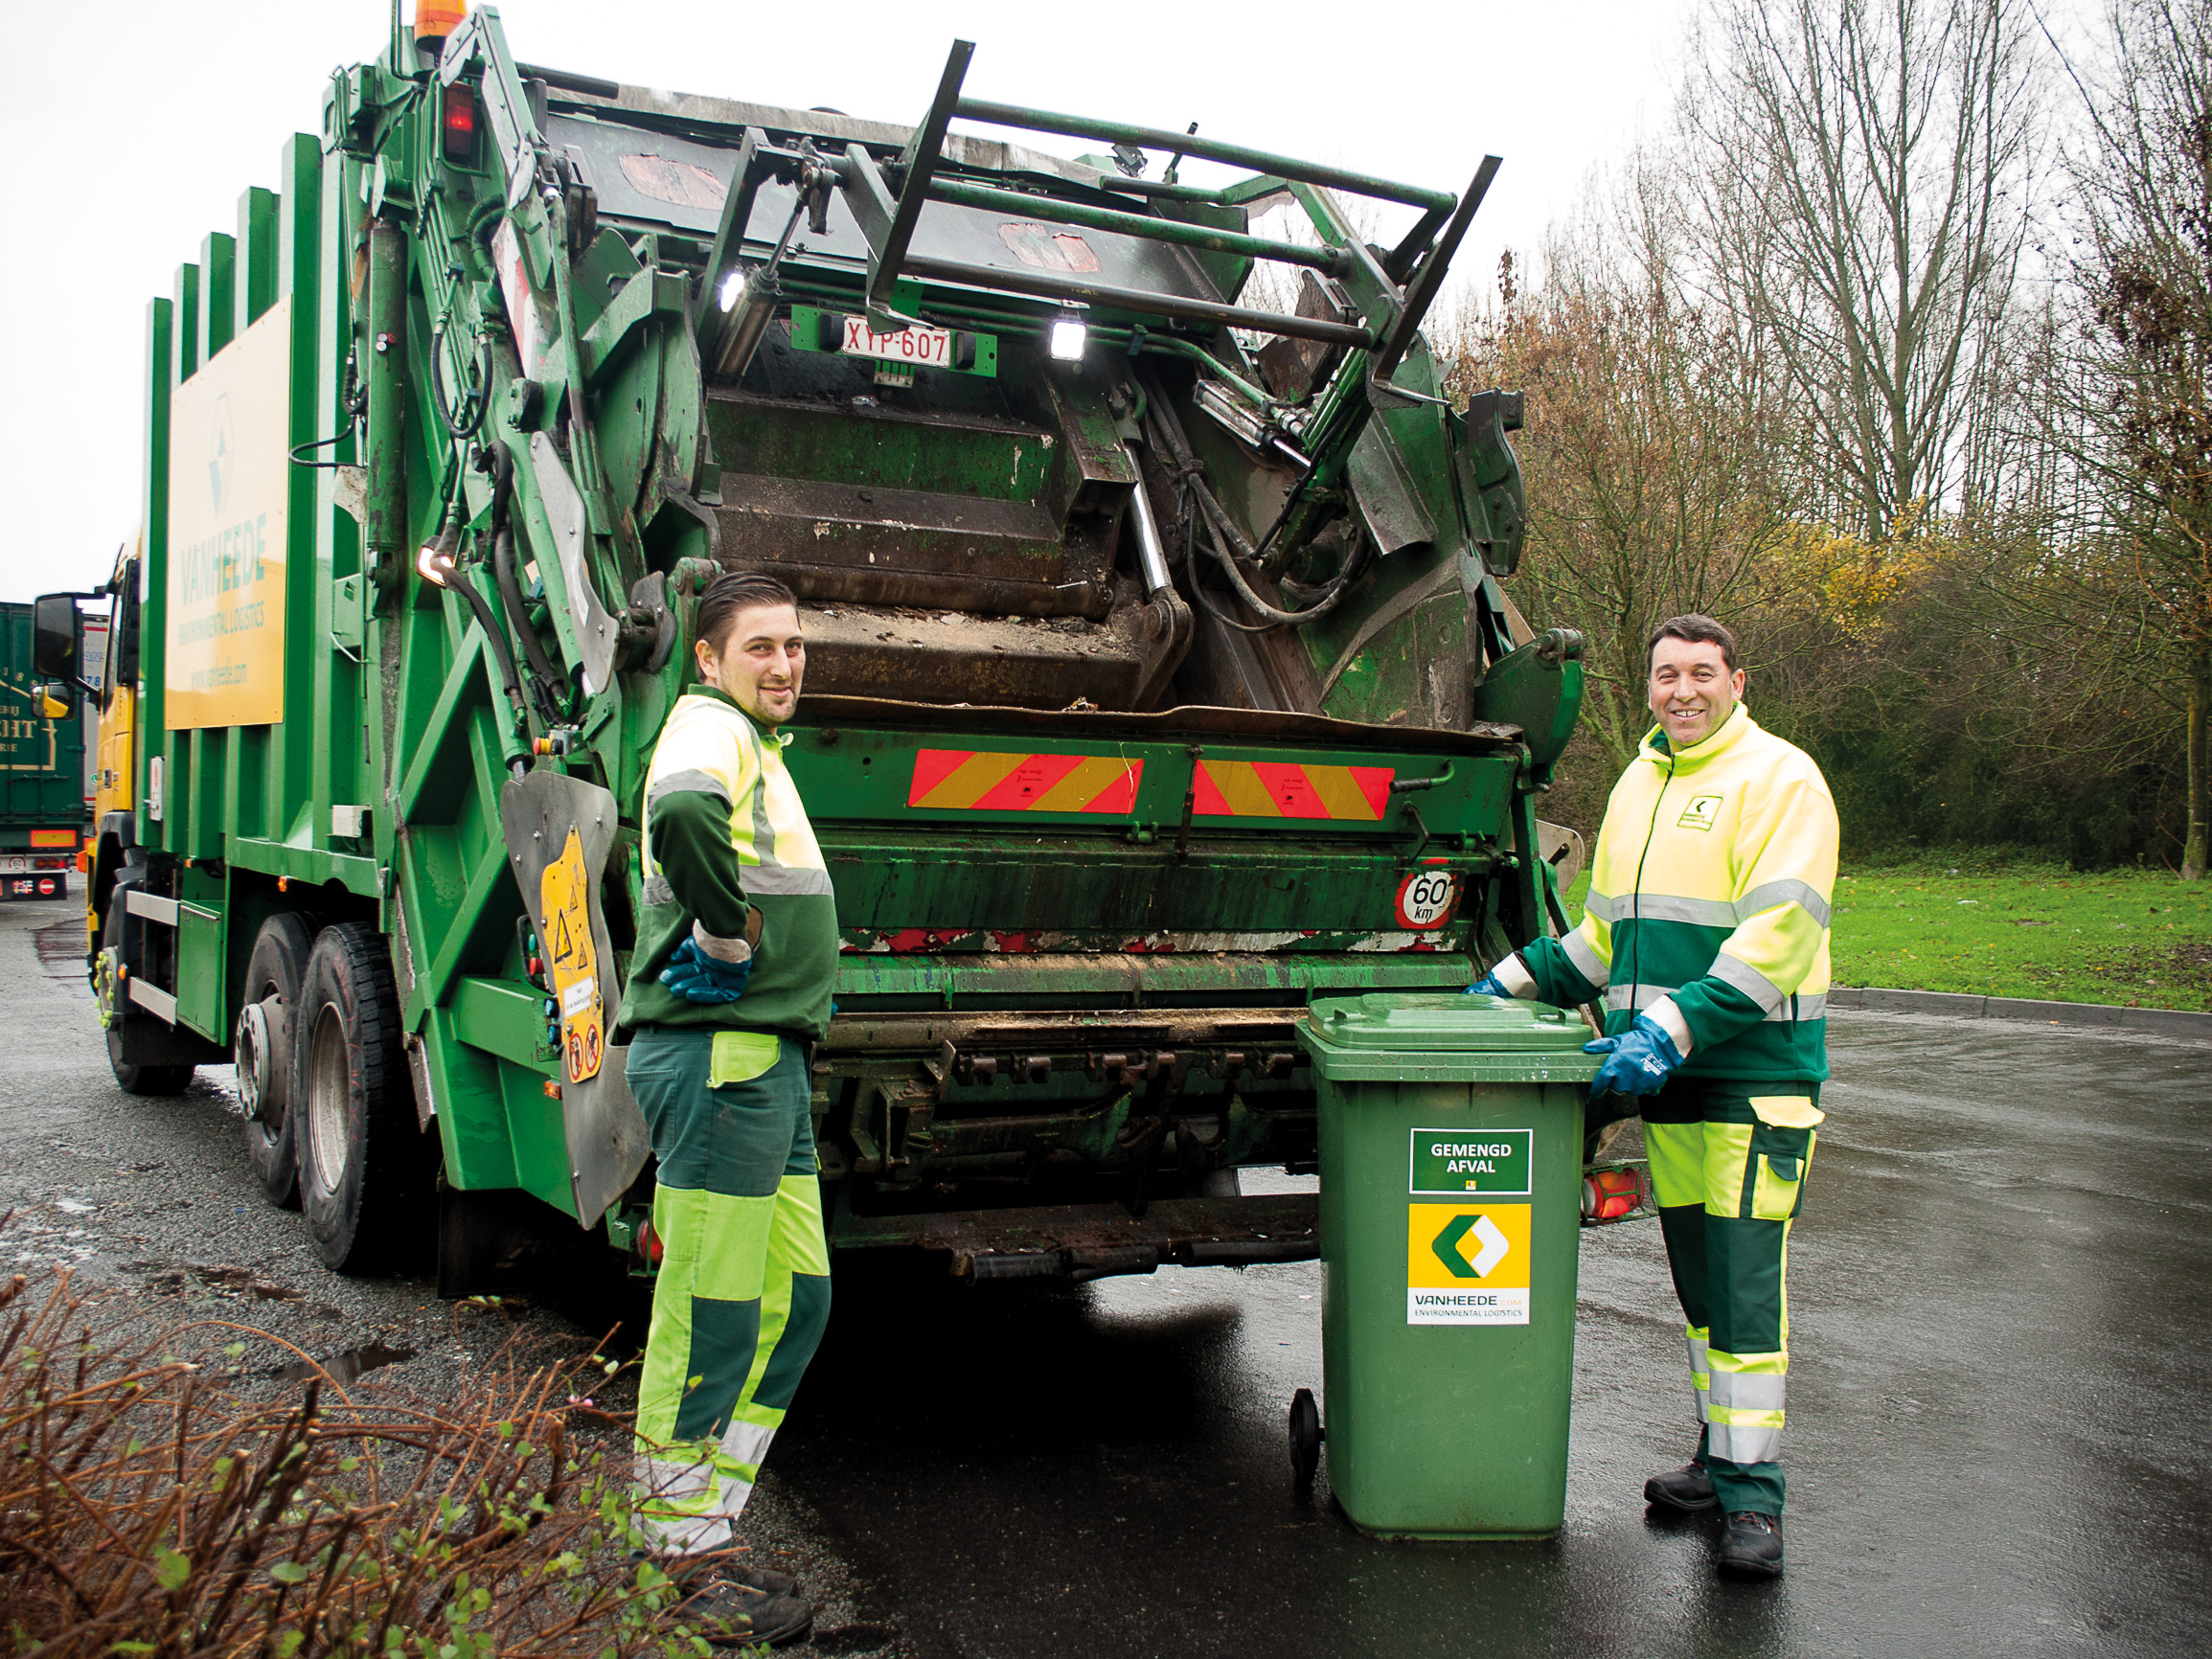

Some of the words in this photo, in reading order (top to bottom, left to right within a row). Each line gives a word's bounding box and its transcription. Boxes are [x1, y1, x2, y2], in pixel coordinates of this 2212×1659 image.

[181, 512, 266, 605] VANHEEDE
[1413, 878, 1448, 905] 60
[1414, 906, 1433, 920] km
[1430, 1144, 1512, 1157] GEMENGD
[1447, 1160, 1495, 1173] AFVAL
[1415, 1295, 1497, 1306] VANHEEDE
